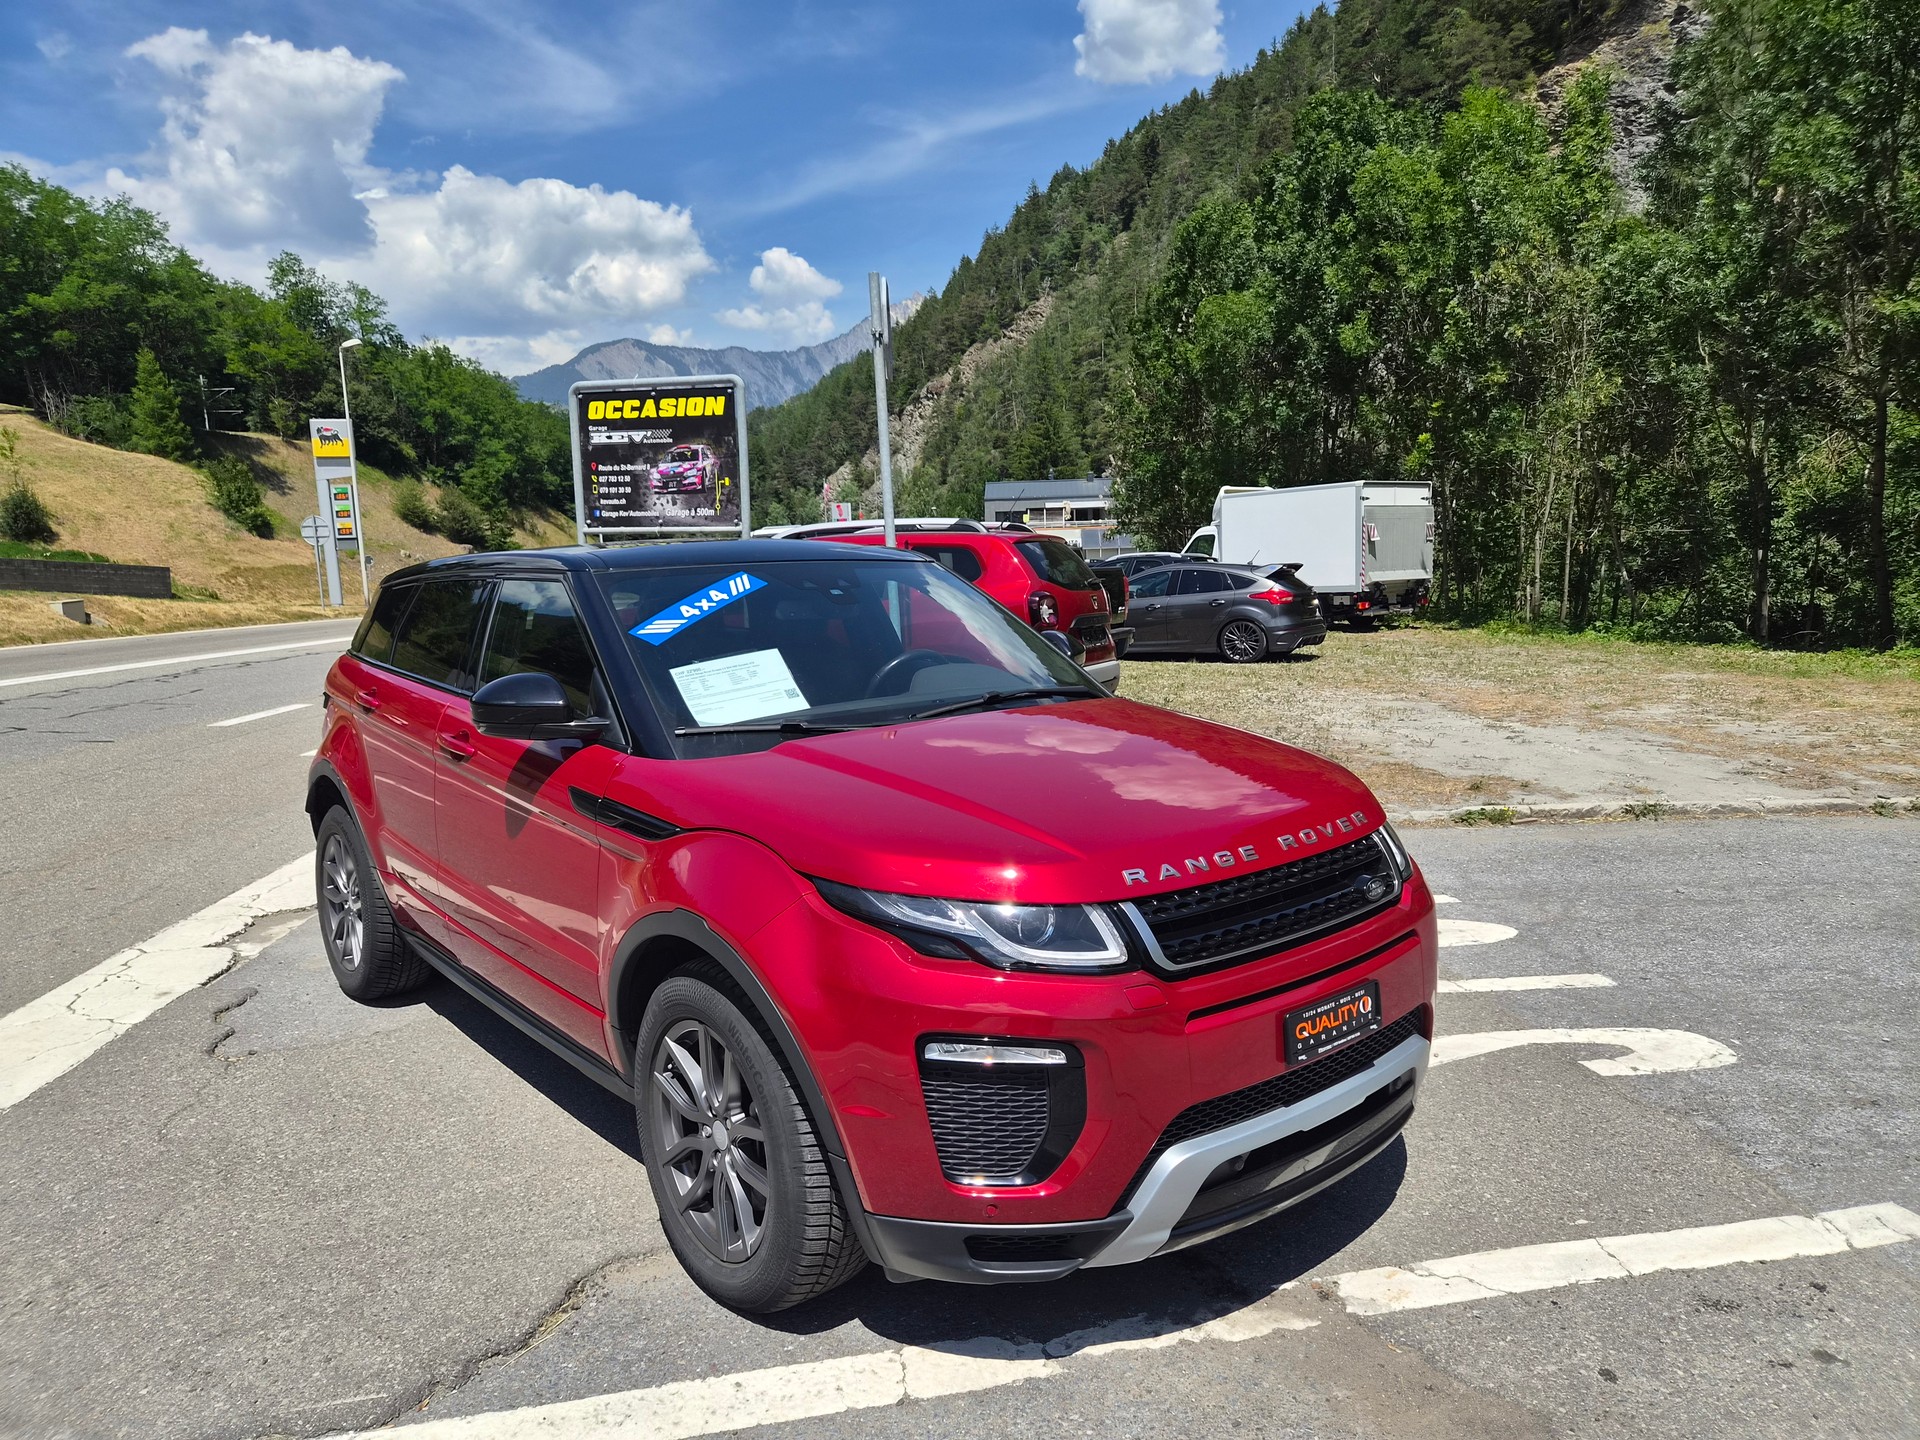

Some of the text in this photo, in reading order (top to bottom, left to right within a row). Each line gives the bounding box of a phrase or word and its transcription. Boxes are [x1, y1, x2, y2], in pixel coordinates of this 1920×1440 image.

[588, 396, 725, 420] OCCASION
[601, 510, 619, 518] Garage
[665, 508, 690, 518] Garage
[1121, 811, 1369, 886] RANGE ROVER
[1296, 1001, 1359, 1040] QUALITY
[1297, 1012, 1373, 1049] GARANTIE
